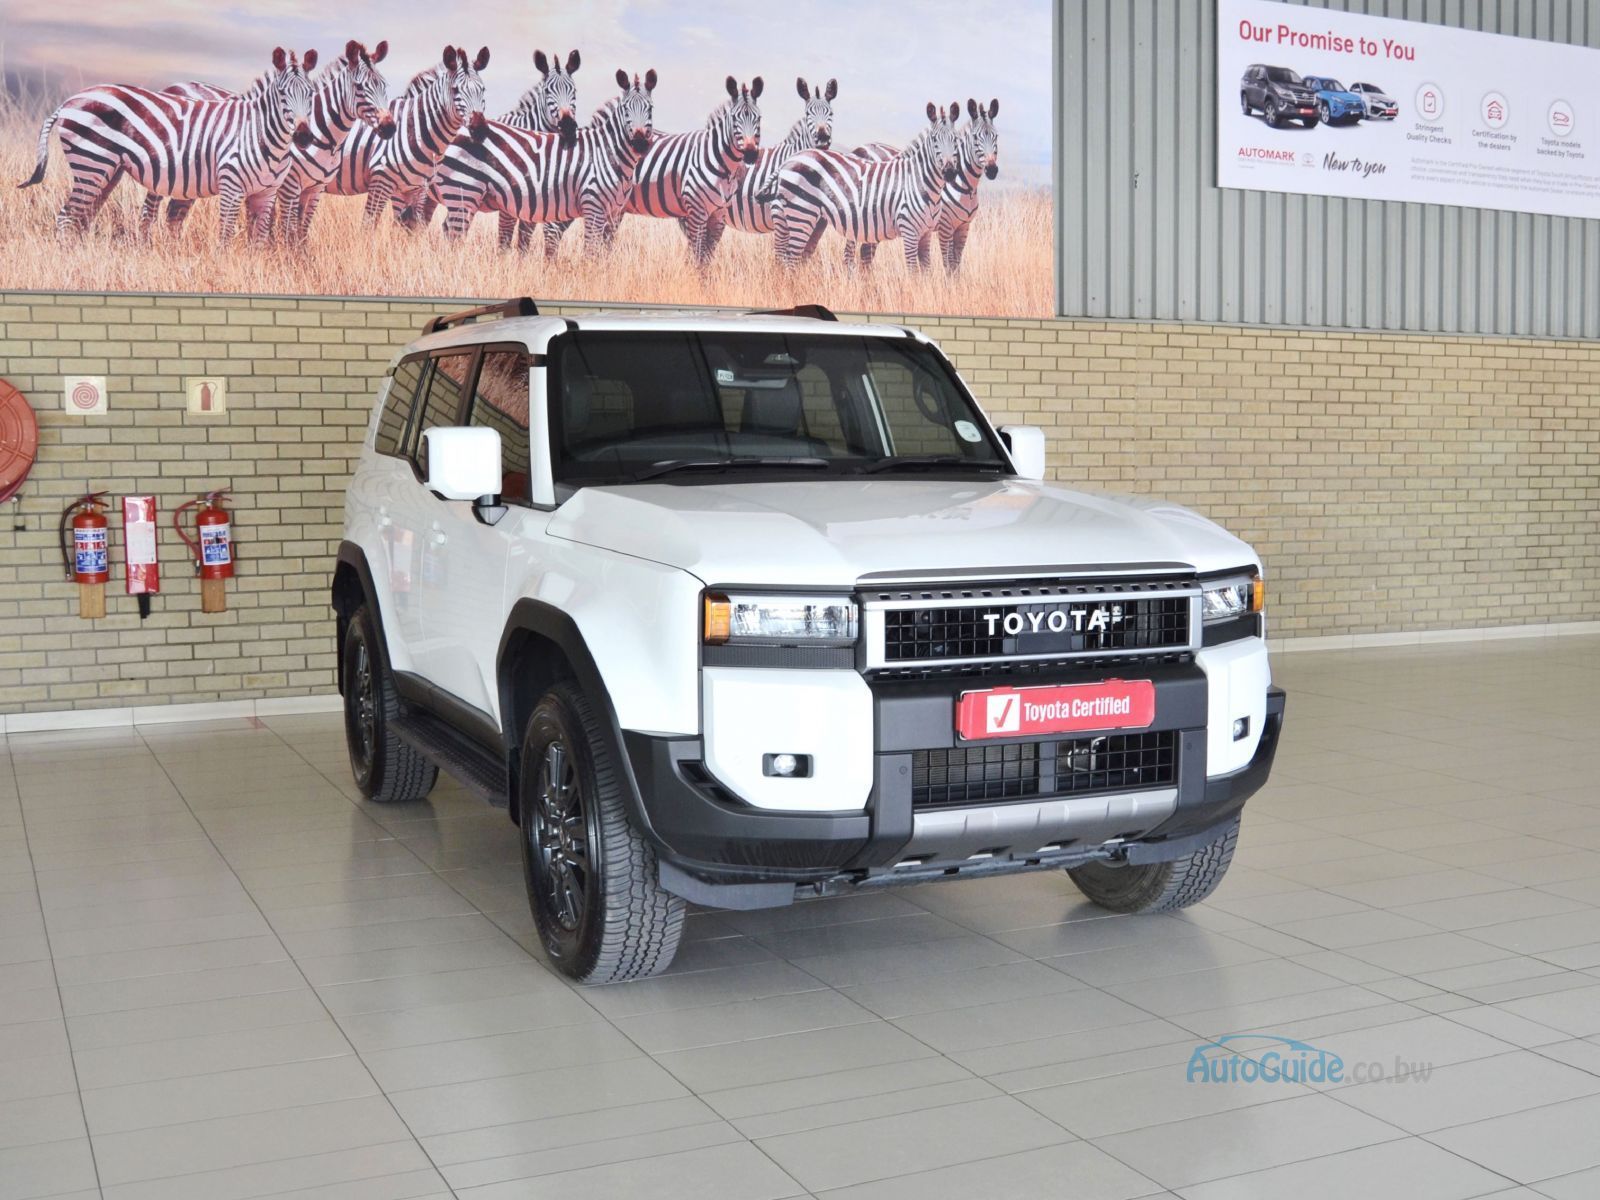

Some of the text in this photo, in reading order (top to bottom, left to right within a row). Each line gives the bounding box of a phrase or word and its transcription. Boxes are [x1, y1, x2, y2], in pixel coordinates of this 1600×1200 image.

[1240, 20, 1415, 61] Our Promise to You
[1406, 132, 1452, 144] Quality Checks
[1471, 129, 1518, 143] Certification by
[1541, 136, 1581, 149] Toyota models
[1478, 141, 1511, 151] the dealers
[1238, 147, 1295, 162] AUTOMARK
[1537, 148, 1584, 159] backed by Toyota
[1323, 151, 1386, 178] New to you
[983, 609, 1107, 636] TOYOTA
[1023, 695, 1130, 722] Toyota Certified
